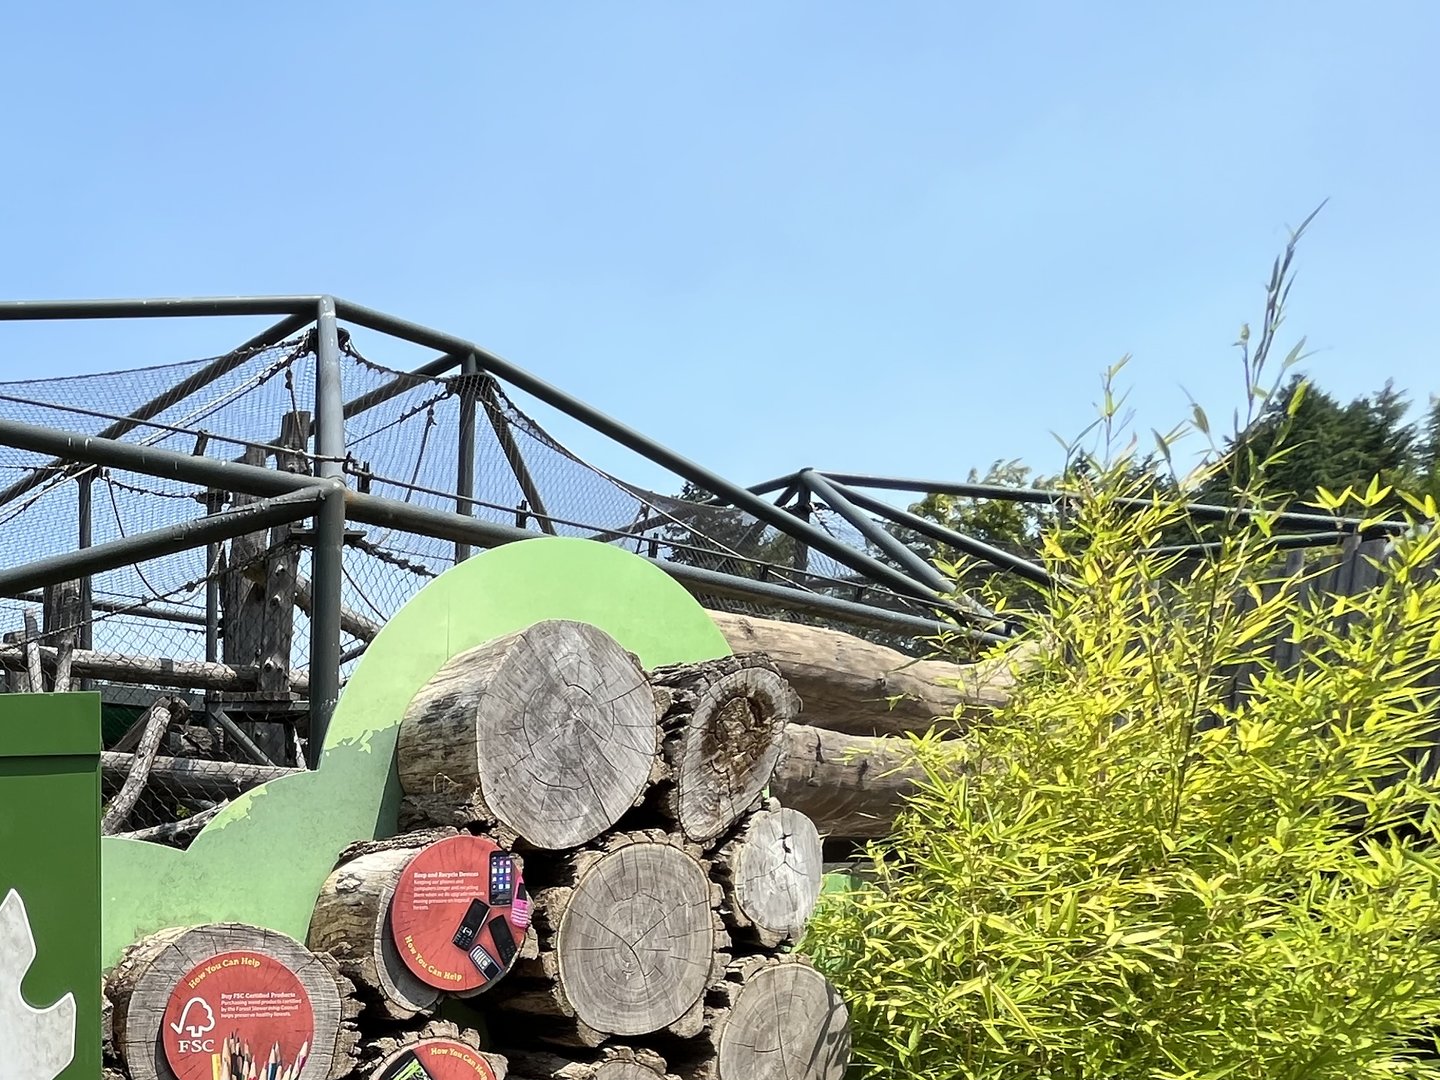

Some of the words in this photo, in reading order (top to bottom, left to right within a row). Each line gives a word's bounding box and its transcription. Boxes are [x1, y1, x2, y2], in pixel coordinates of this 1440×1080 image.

[404, 935, 417, 954] How
[414, 953, 427, 969] You
[428, 965, 442, 978] Can
[443, 970, 463, 982] Help
[188, 972, 207, 989] How
[206, 963, 222, 974] You
[222, 958, 239, 968] Can
[241, 957, 261, 968] Help
[178, 1039, 215, 1053] FSC
[431, 1047, 448, 1056] How
[449, 1048, 463, 1060] You
[463, 1054, 477, 1067] Can
